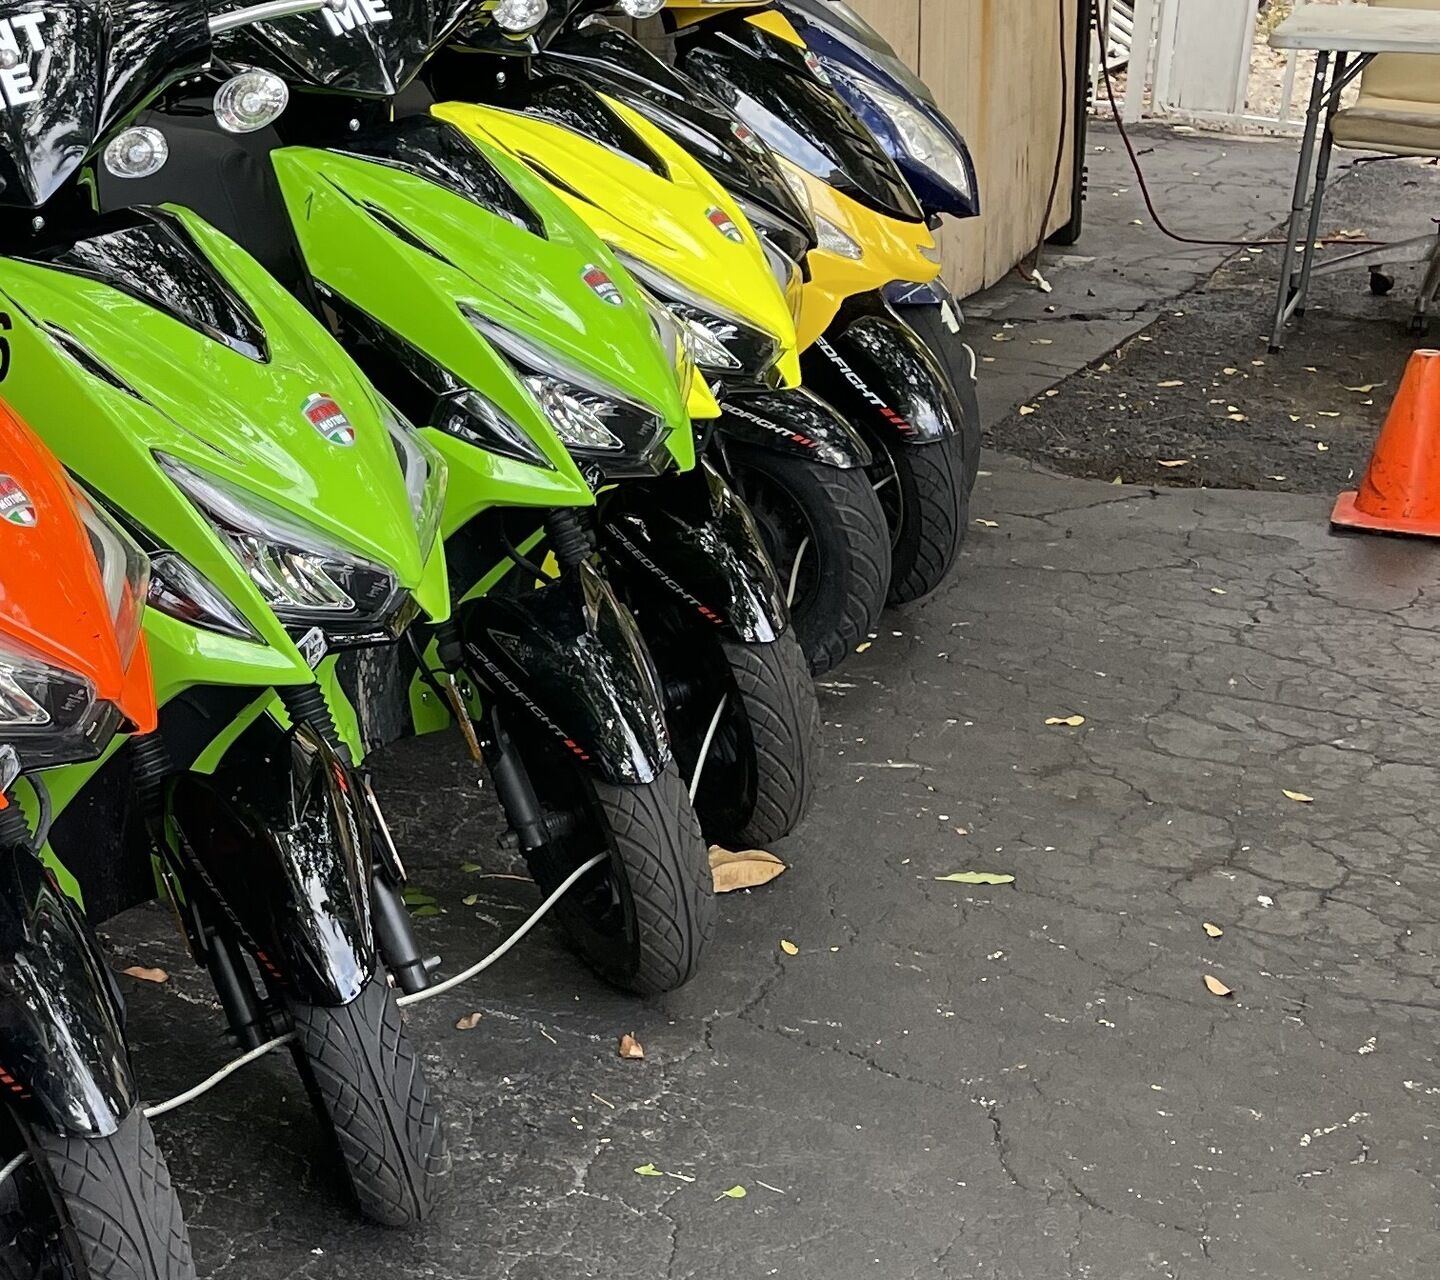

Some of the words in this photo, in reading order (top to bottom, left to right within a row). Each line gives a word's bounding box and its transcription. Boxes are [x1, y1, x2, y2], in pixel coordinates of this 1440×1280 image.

[815, 335, 888, 408] EDFIGHT
[719, 402, 796, 436] EDFIGHT
[605, 523, 702, 606] SPEEDFIGHT
[465, 642, 569, 738] SPEEDFIGHT
